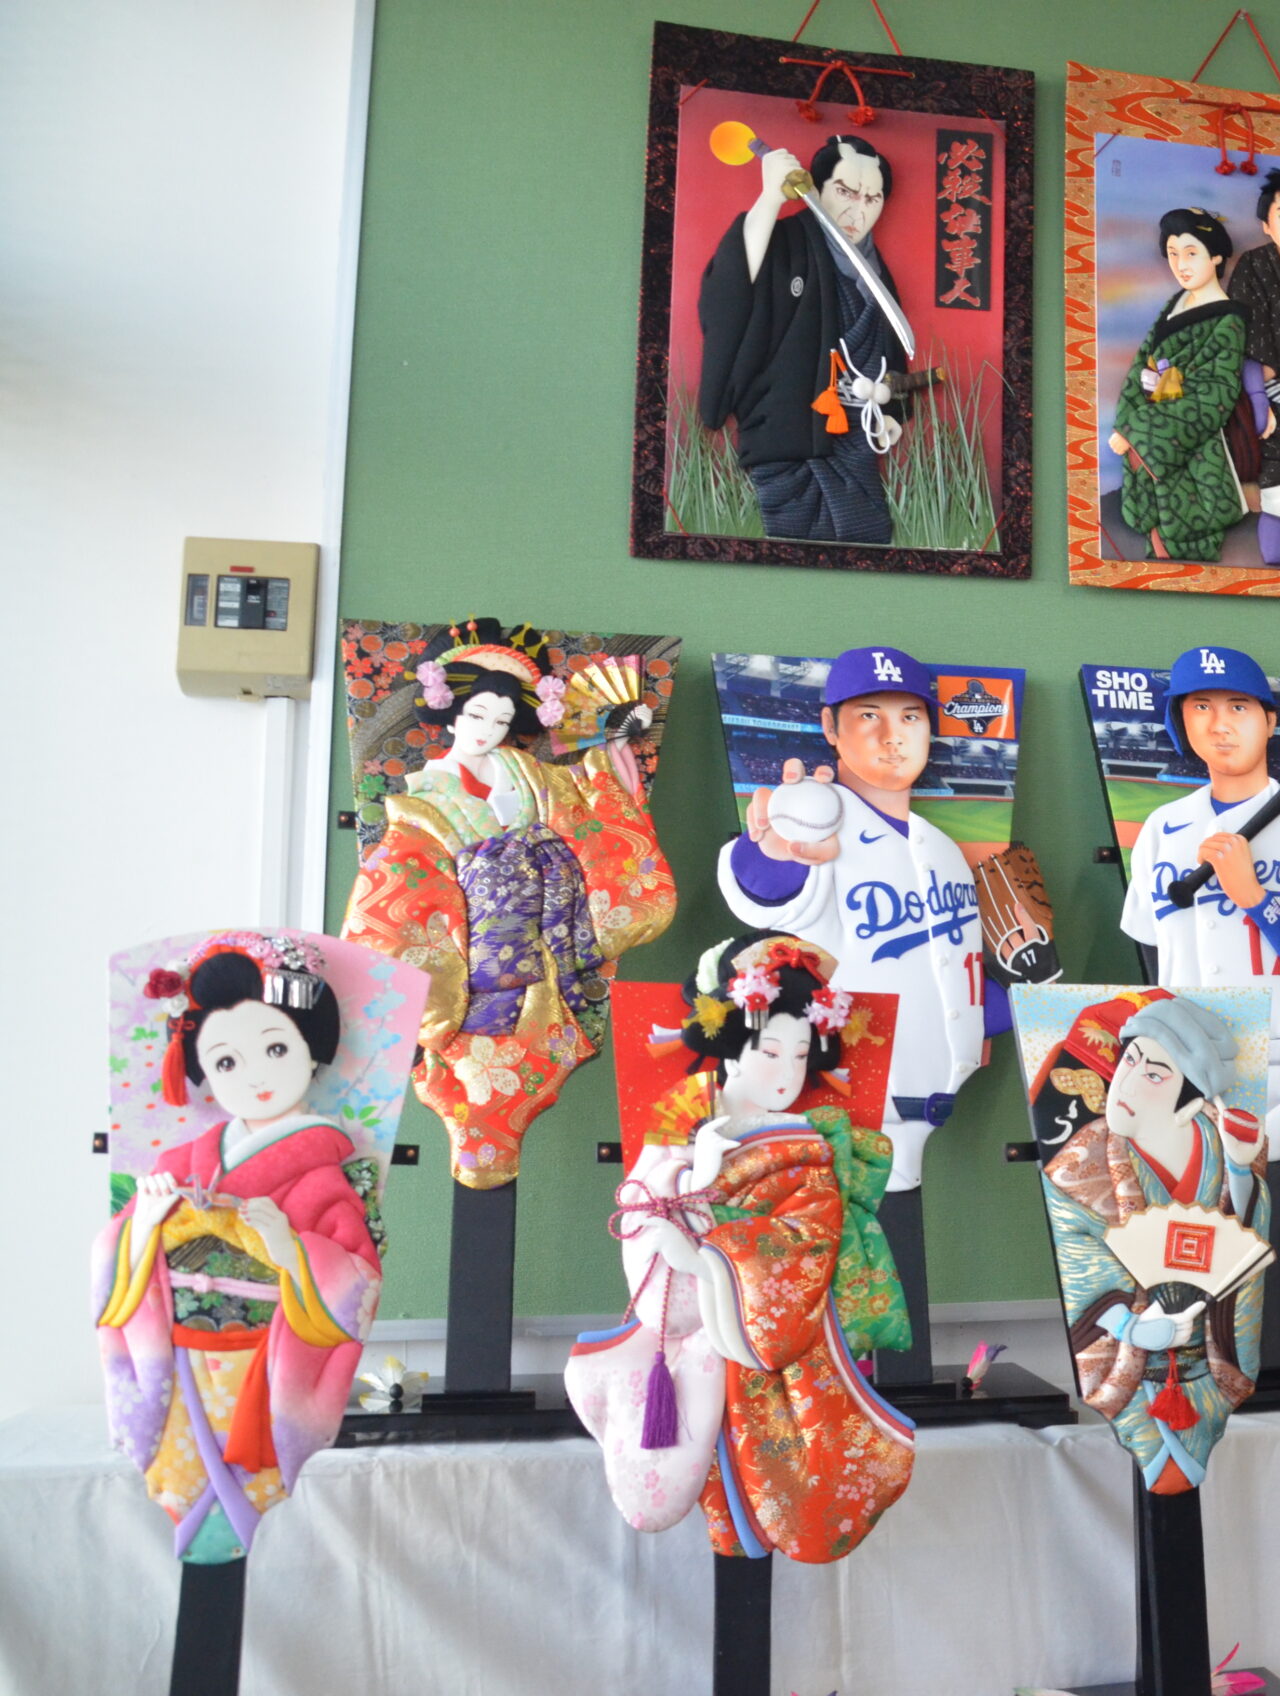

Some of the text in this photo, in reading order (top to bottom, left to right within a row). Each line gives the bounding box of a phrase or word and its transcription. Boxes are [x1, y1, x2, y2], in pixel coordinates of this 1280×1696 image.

[938, 139, 992, 307] 必殺仕事人
[871, 652, 903, 682] LA
[1200, 649, 1225, 674] LA
[1096, 670, 1148, 691] SHO
[944, 701, 1008, 716] Champions
[1092, 689, 1155, 711] TIME
[1021, 949, 1036, 967] 17
